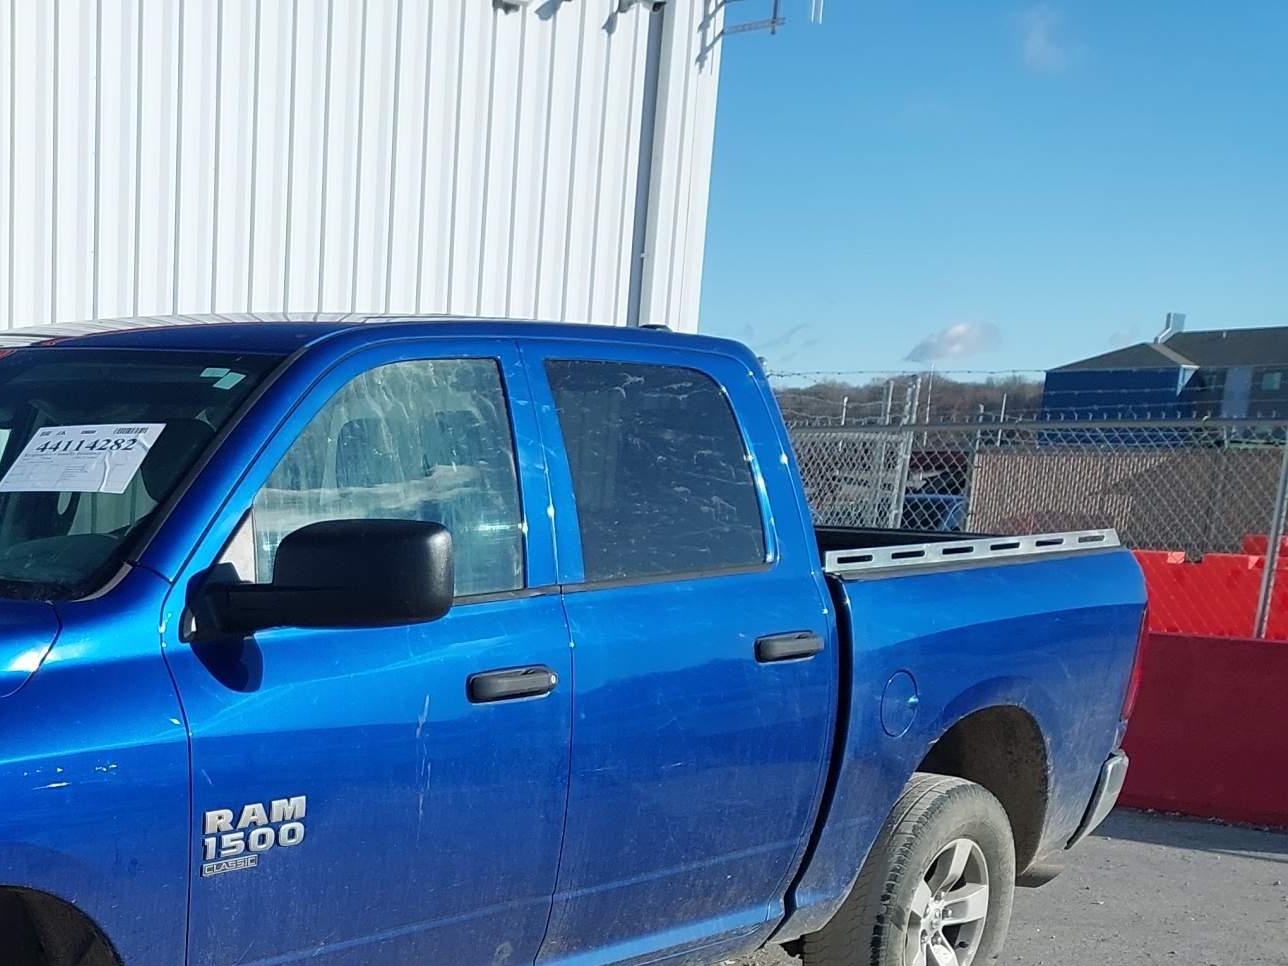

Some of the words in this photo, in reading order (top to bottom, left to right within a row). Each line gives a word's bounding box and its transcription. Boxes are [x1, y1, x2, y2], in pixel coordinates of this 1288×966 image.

[35, 438, 138, 454] 44114282
[204, 795, 307, 835] RAM
[202, 821, 305, 861] 1500
[203, 856, 257, 876] CLASSIC
